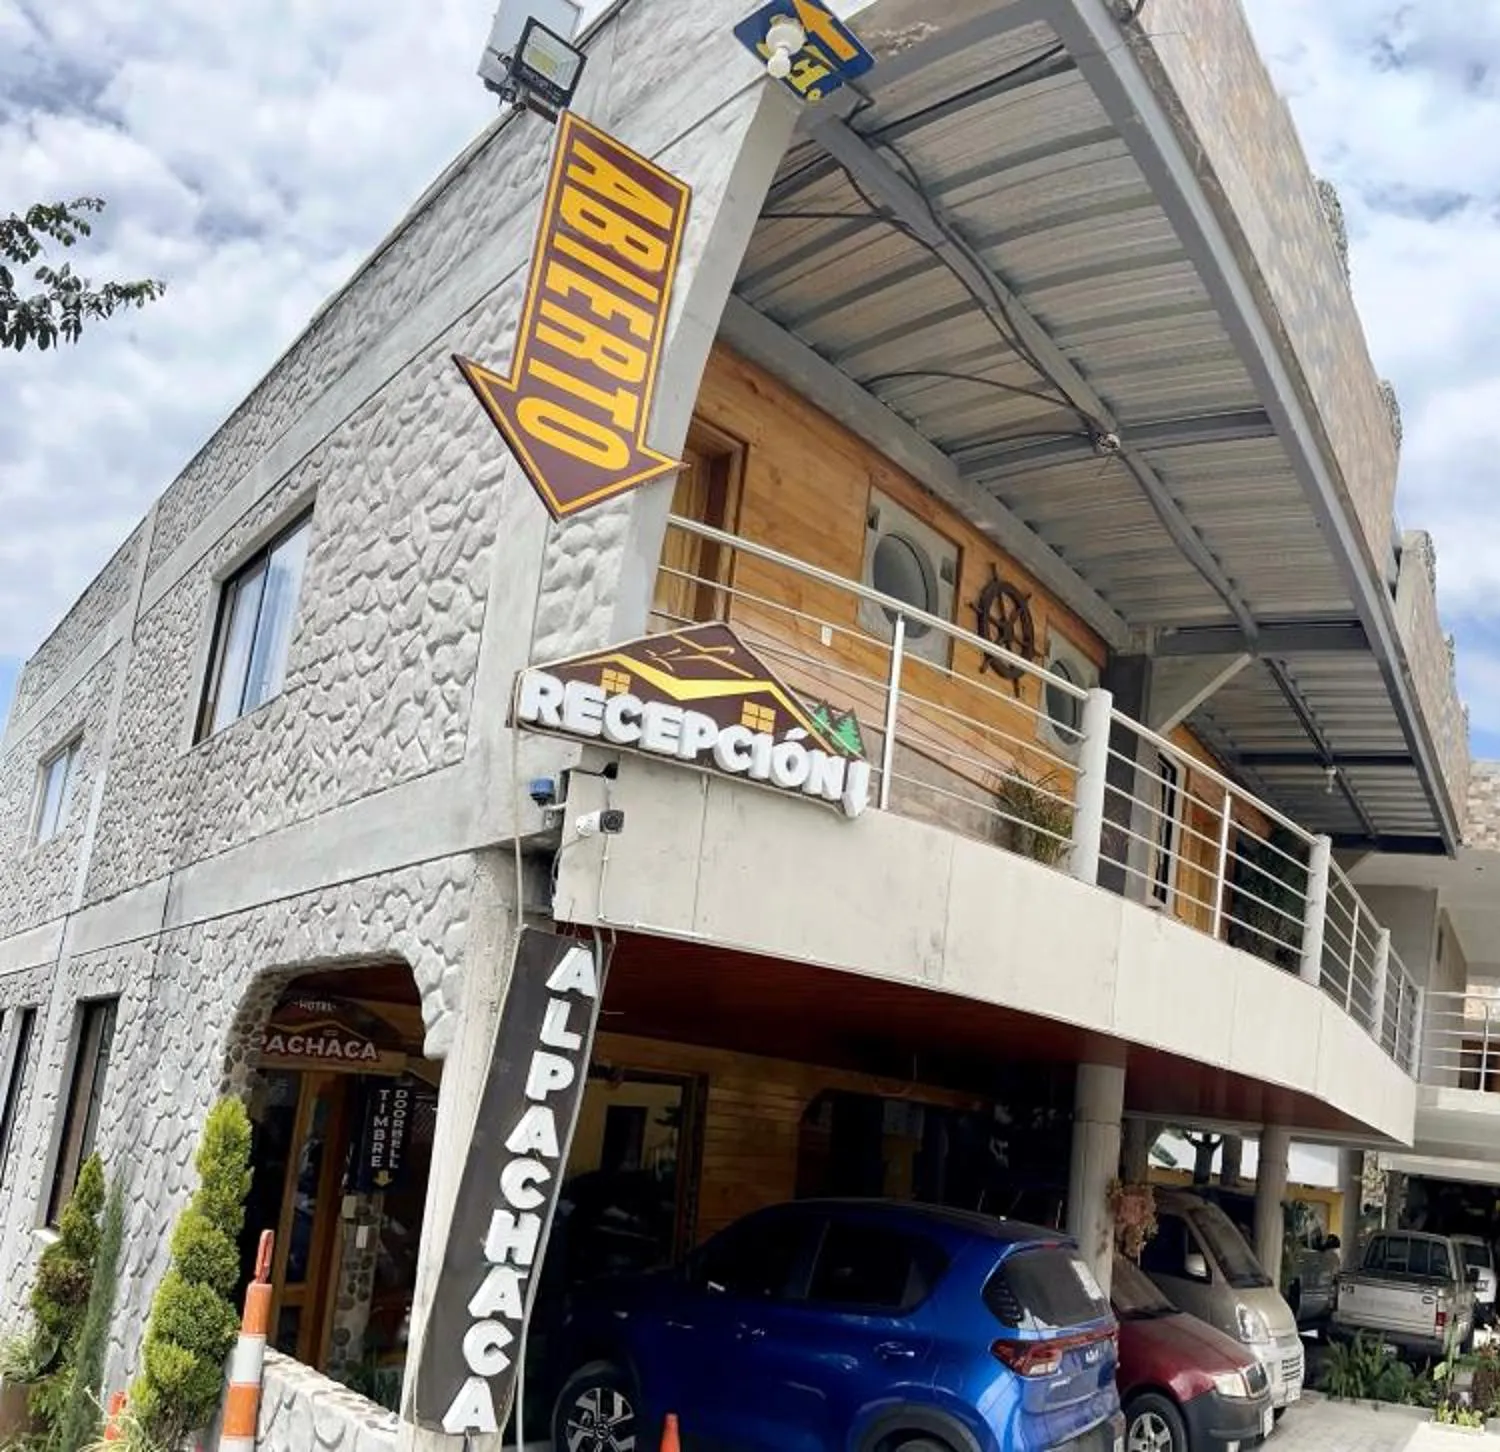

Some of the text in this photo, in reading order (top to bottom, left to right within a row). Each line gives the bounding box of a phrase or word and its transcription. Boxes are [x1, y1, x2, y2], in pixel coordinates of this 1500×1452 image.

[515, 133, 676, 471] ABIERTO
[371, 1089, 390, 1168] TIMBRE
[389, 1089, 409, 1169] DOORBELL
[442, 946, 599, 1434] ALPACHACA
